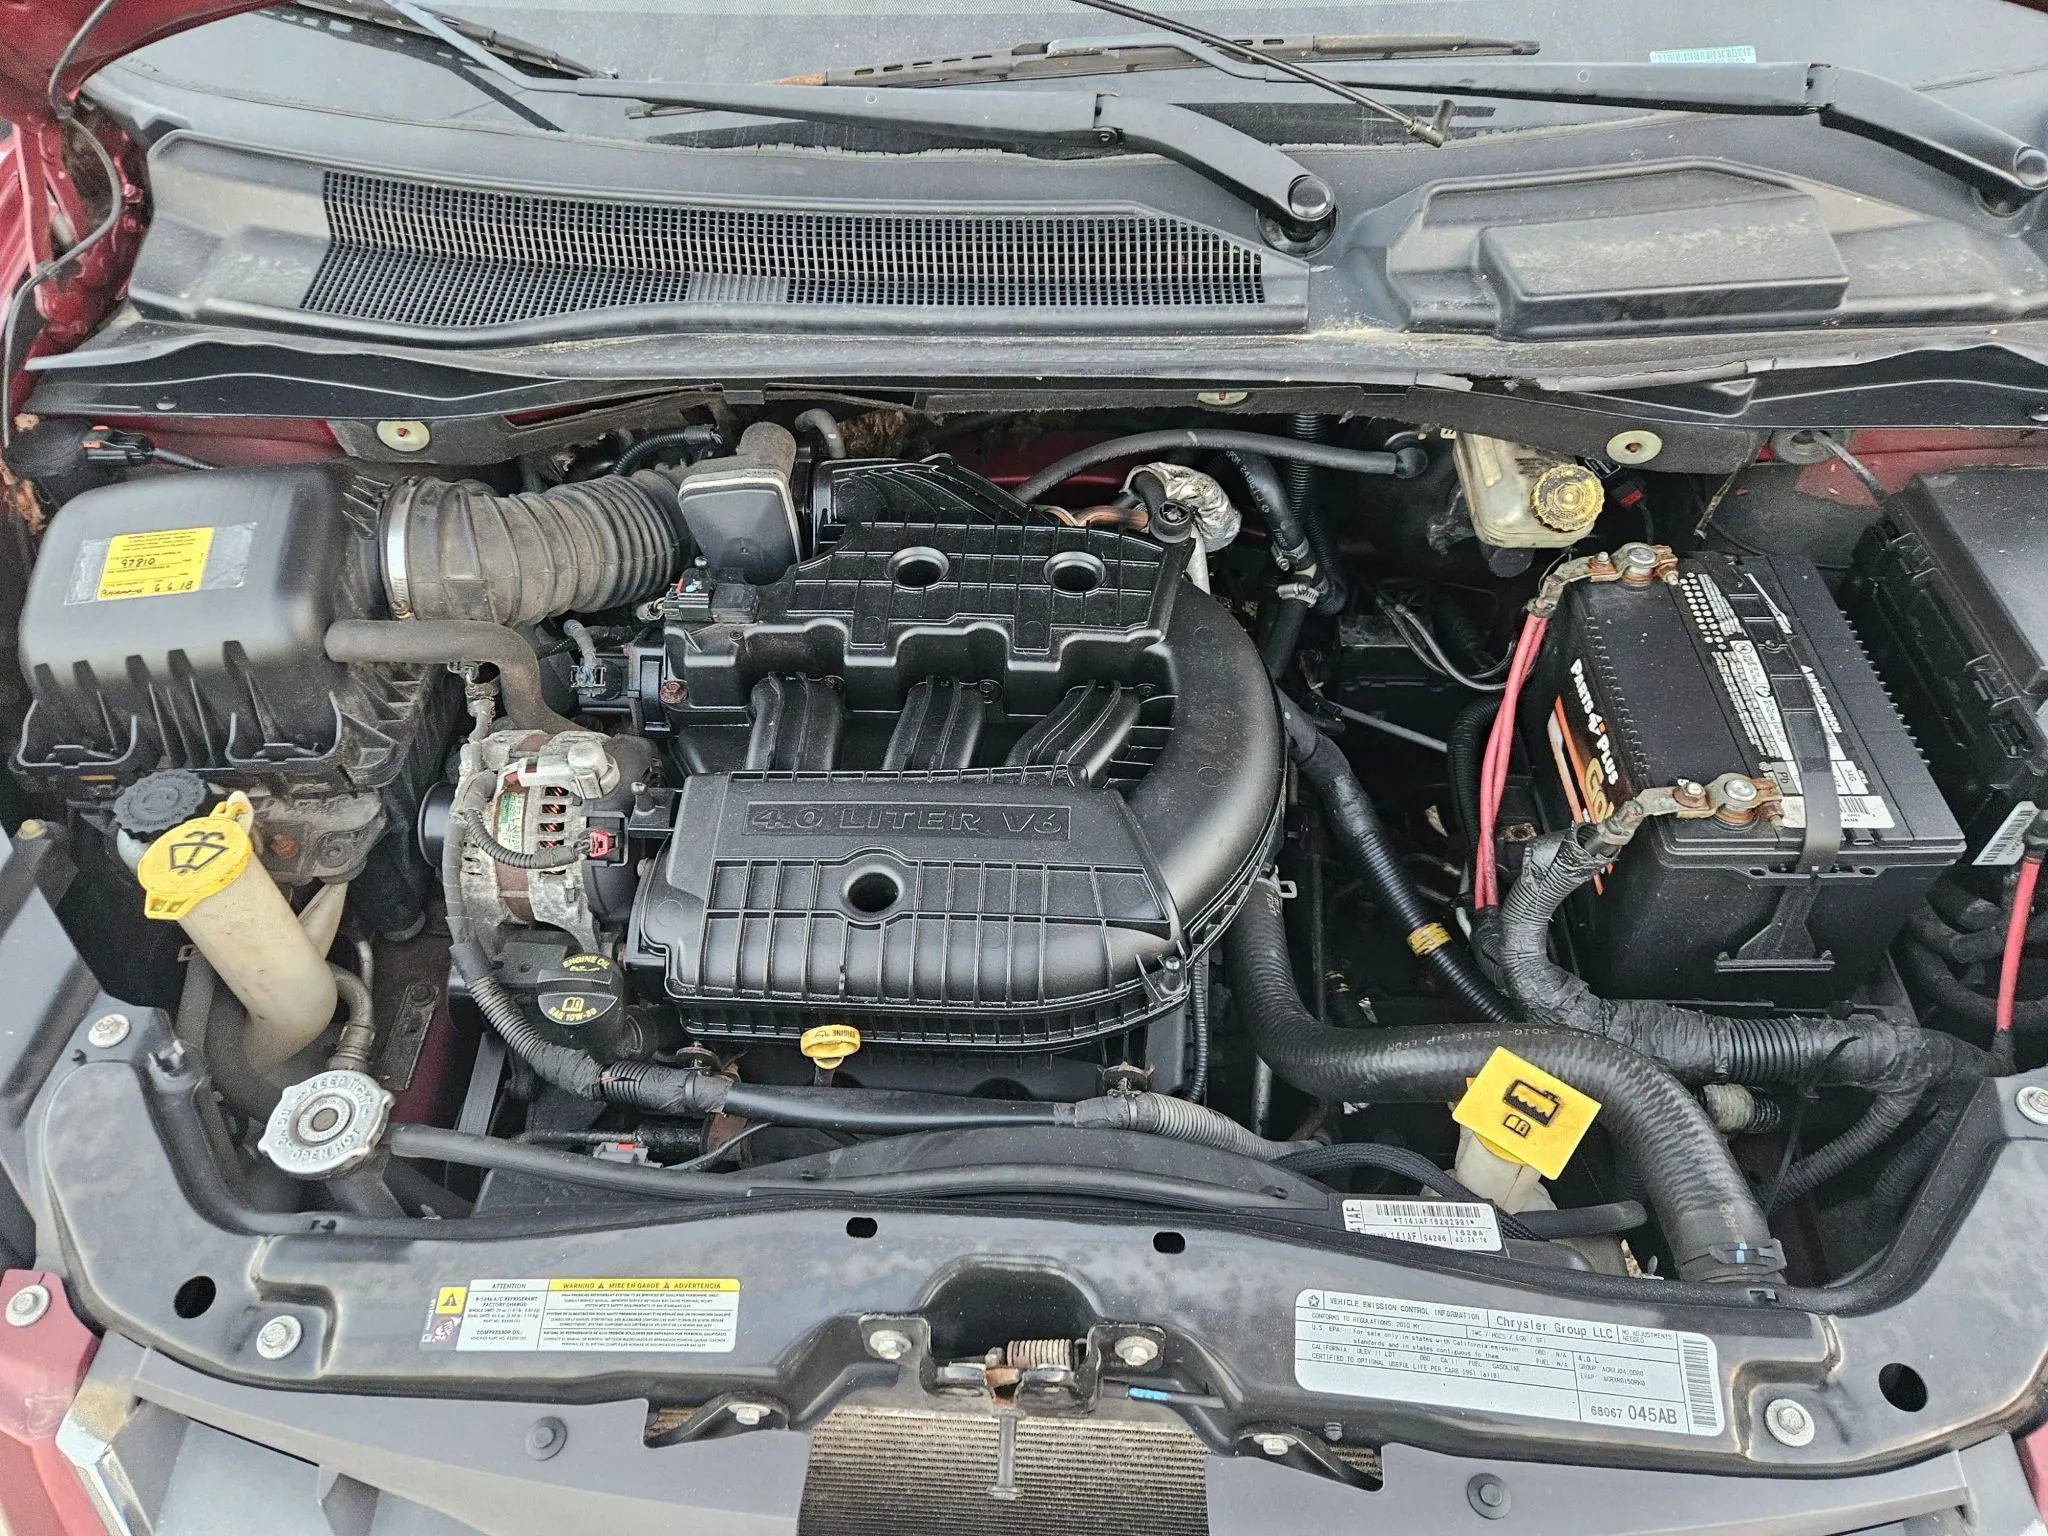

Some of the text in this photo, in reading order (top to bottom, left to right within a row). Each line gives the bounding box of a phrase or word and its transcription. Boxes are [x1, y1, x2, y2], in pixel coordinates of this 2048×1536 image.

[121, 557, 156, 568] 97810
[1570, 658, 1619, 785] PARTS PLUS
[839, 808, 991, 835] LITER
[1002, 810, 1062, 834] V6
[562, 955, 611, 970] ENGINE OIL
[547, 1006, 597, 1022] SAE 10W-30
[831, 1029, 856, 1039] ENGINE
[307, 1075, 348, 1095] KEEP
[291, 1146, 331, 1161] OPEN
[335, 1126, 361, 1152] HOT
[1311, 1312, 1340, 1321] CONFORMS
[1329, 1297, 1613, 1339] VEHICLE EMISSION CONTROL INFORMATION Chrysler Group LLC
[1384, 1332, 1399, 1340] only
[1412, 1335, 1433, 1343] states
[1435, 1337, 1450, 1345] with
[1452, 1339, 1488, 1349] California
[1491, 1345, 1519, 1353] emission
[1472, 1329, 1482, 1337] TWC
[1632, 1330, 1673, 1341] ADJUSTMENTS
[1353, 1338, 1385, 1347] standards
[1436, 1347, 1471, 1358] contiguous
[1311, 1352, 1344, 1362] CERTIFIED
[1356, 1357, 1385, 1367] OPTIONAL
[1388, 1360, 1409, 1369] USEFUL
[1413, 1363, 1428, 1371] LIFE
[1444, 1367, 1460, 1375] CARB
[1356, 1347, 1371, 1355] ULEV
[1491, 1363, 1521, 1373] GASOLINE
[1578, 1355, 1591, 1363] 4.0
[1590, 1404, 1678, 1425] 68067 045AB
